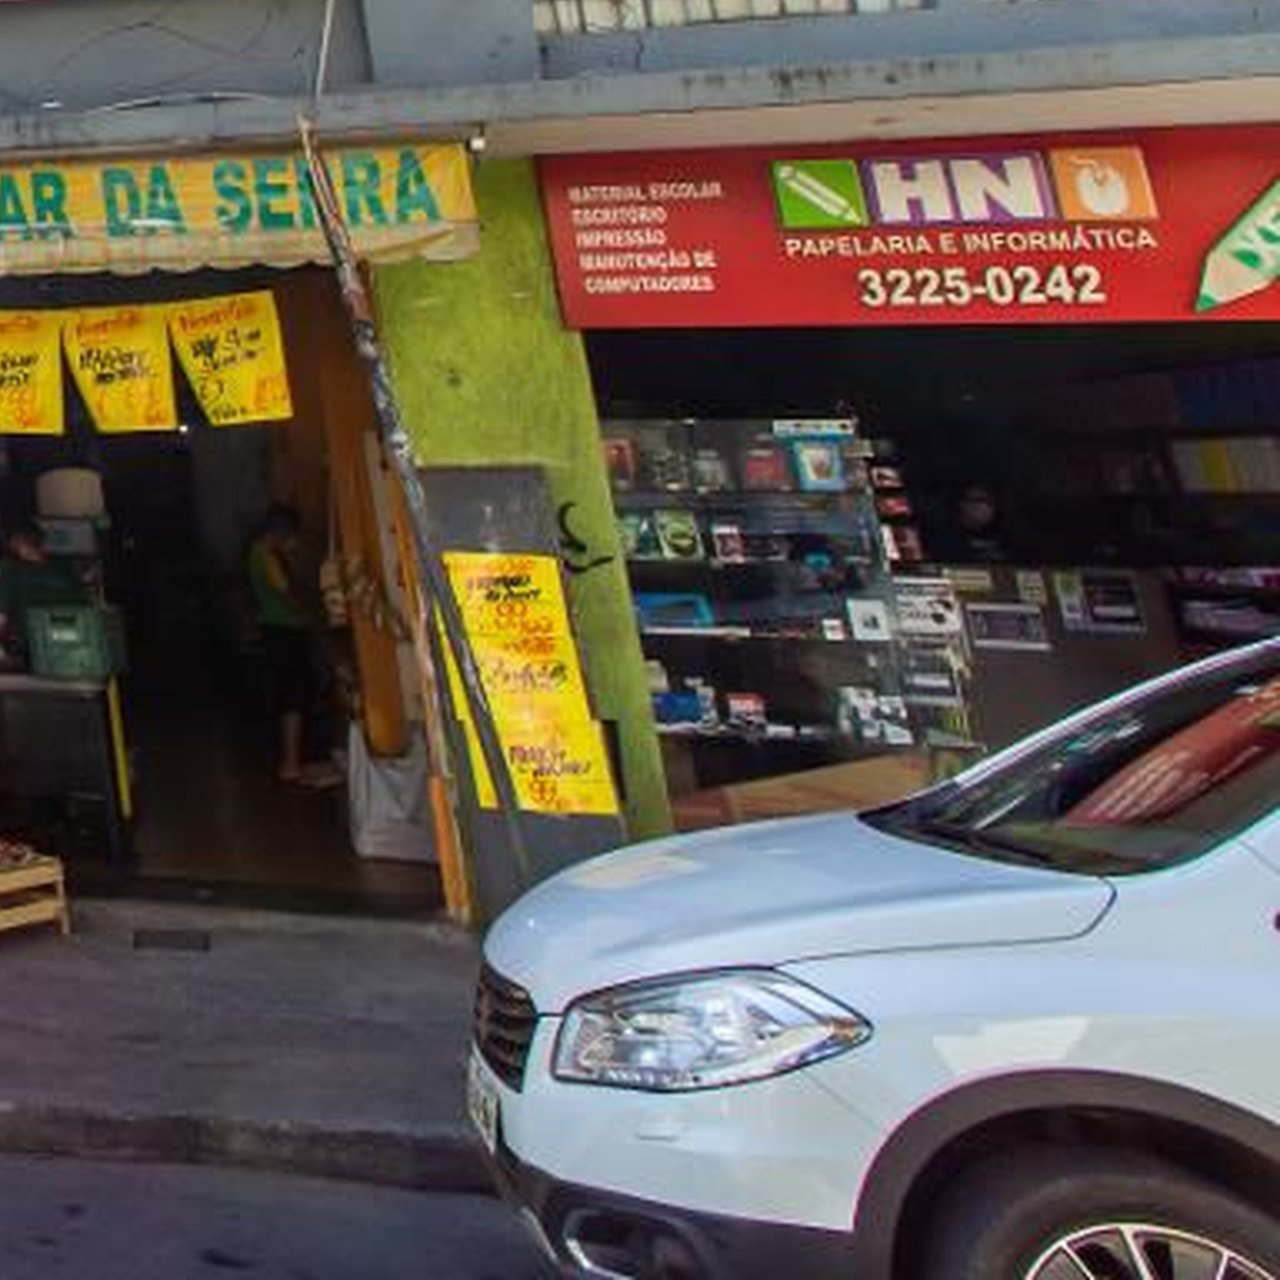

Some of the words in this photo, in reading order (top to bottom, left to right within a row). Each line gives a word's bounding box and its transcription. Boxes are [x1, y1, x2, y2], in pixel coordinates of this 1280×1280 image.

[101, 165, 187, 238] DA
[568, 185, 646, 203] MATERIAL
[649, 181, 723, 200] ESCOLAR
[872, 157, 1044, 223] HN
[572, 206, 668, 225] ESCRITÓRIO
[576, 227, 667, 248] IMPRESSÃO
[785, 234, 933, 257] PAPELARIA
[941, 233, 959, 254] E
[962, 226, 1159, 253] INFORMÁTICA
[579, 249, 690, 272] MANUTENÇÃO
[692, 250, 718, 269] DE
[585, 274, 716, 294] COMPUTADORES
[858, 265, 1107, 306] 3225-0242
